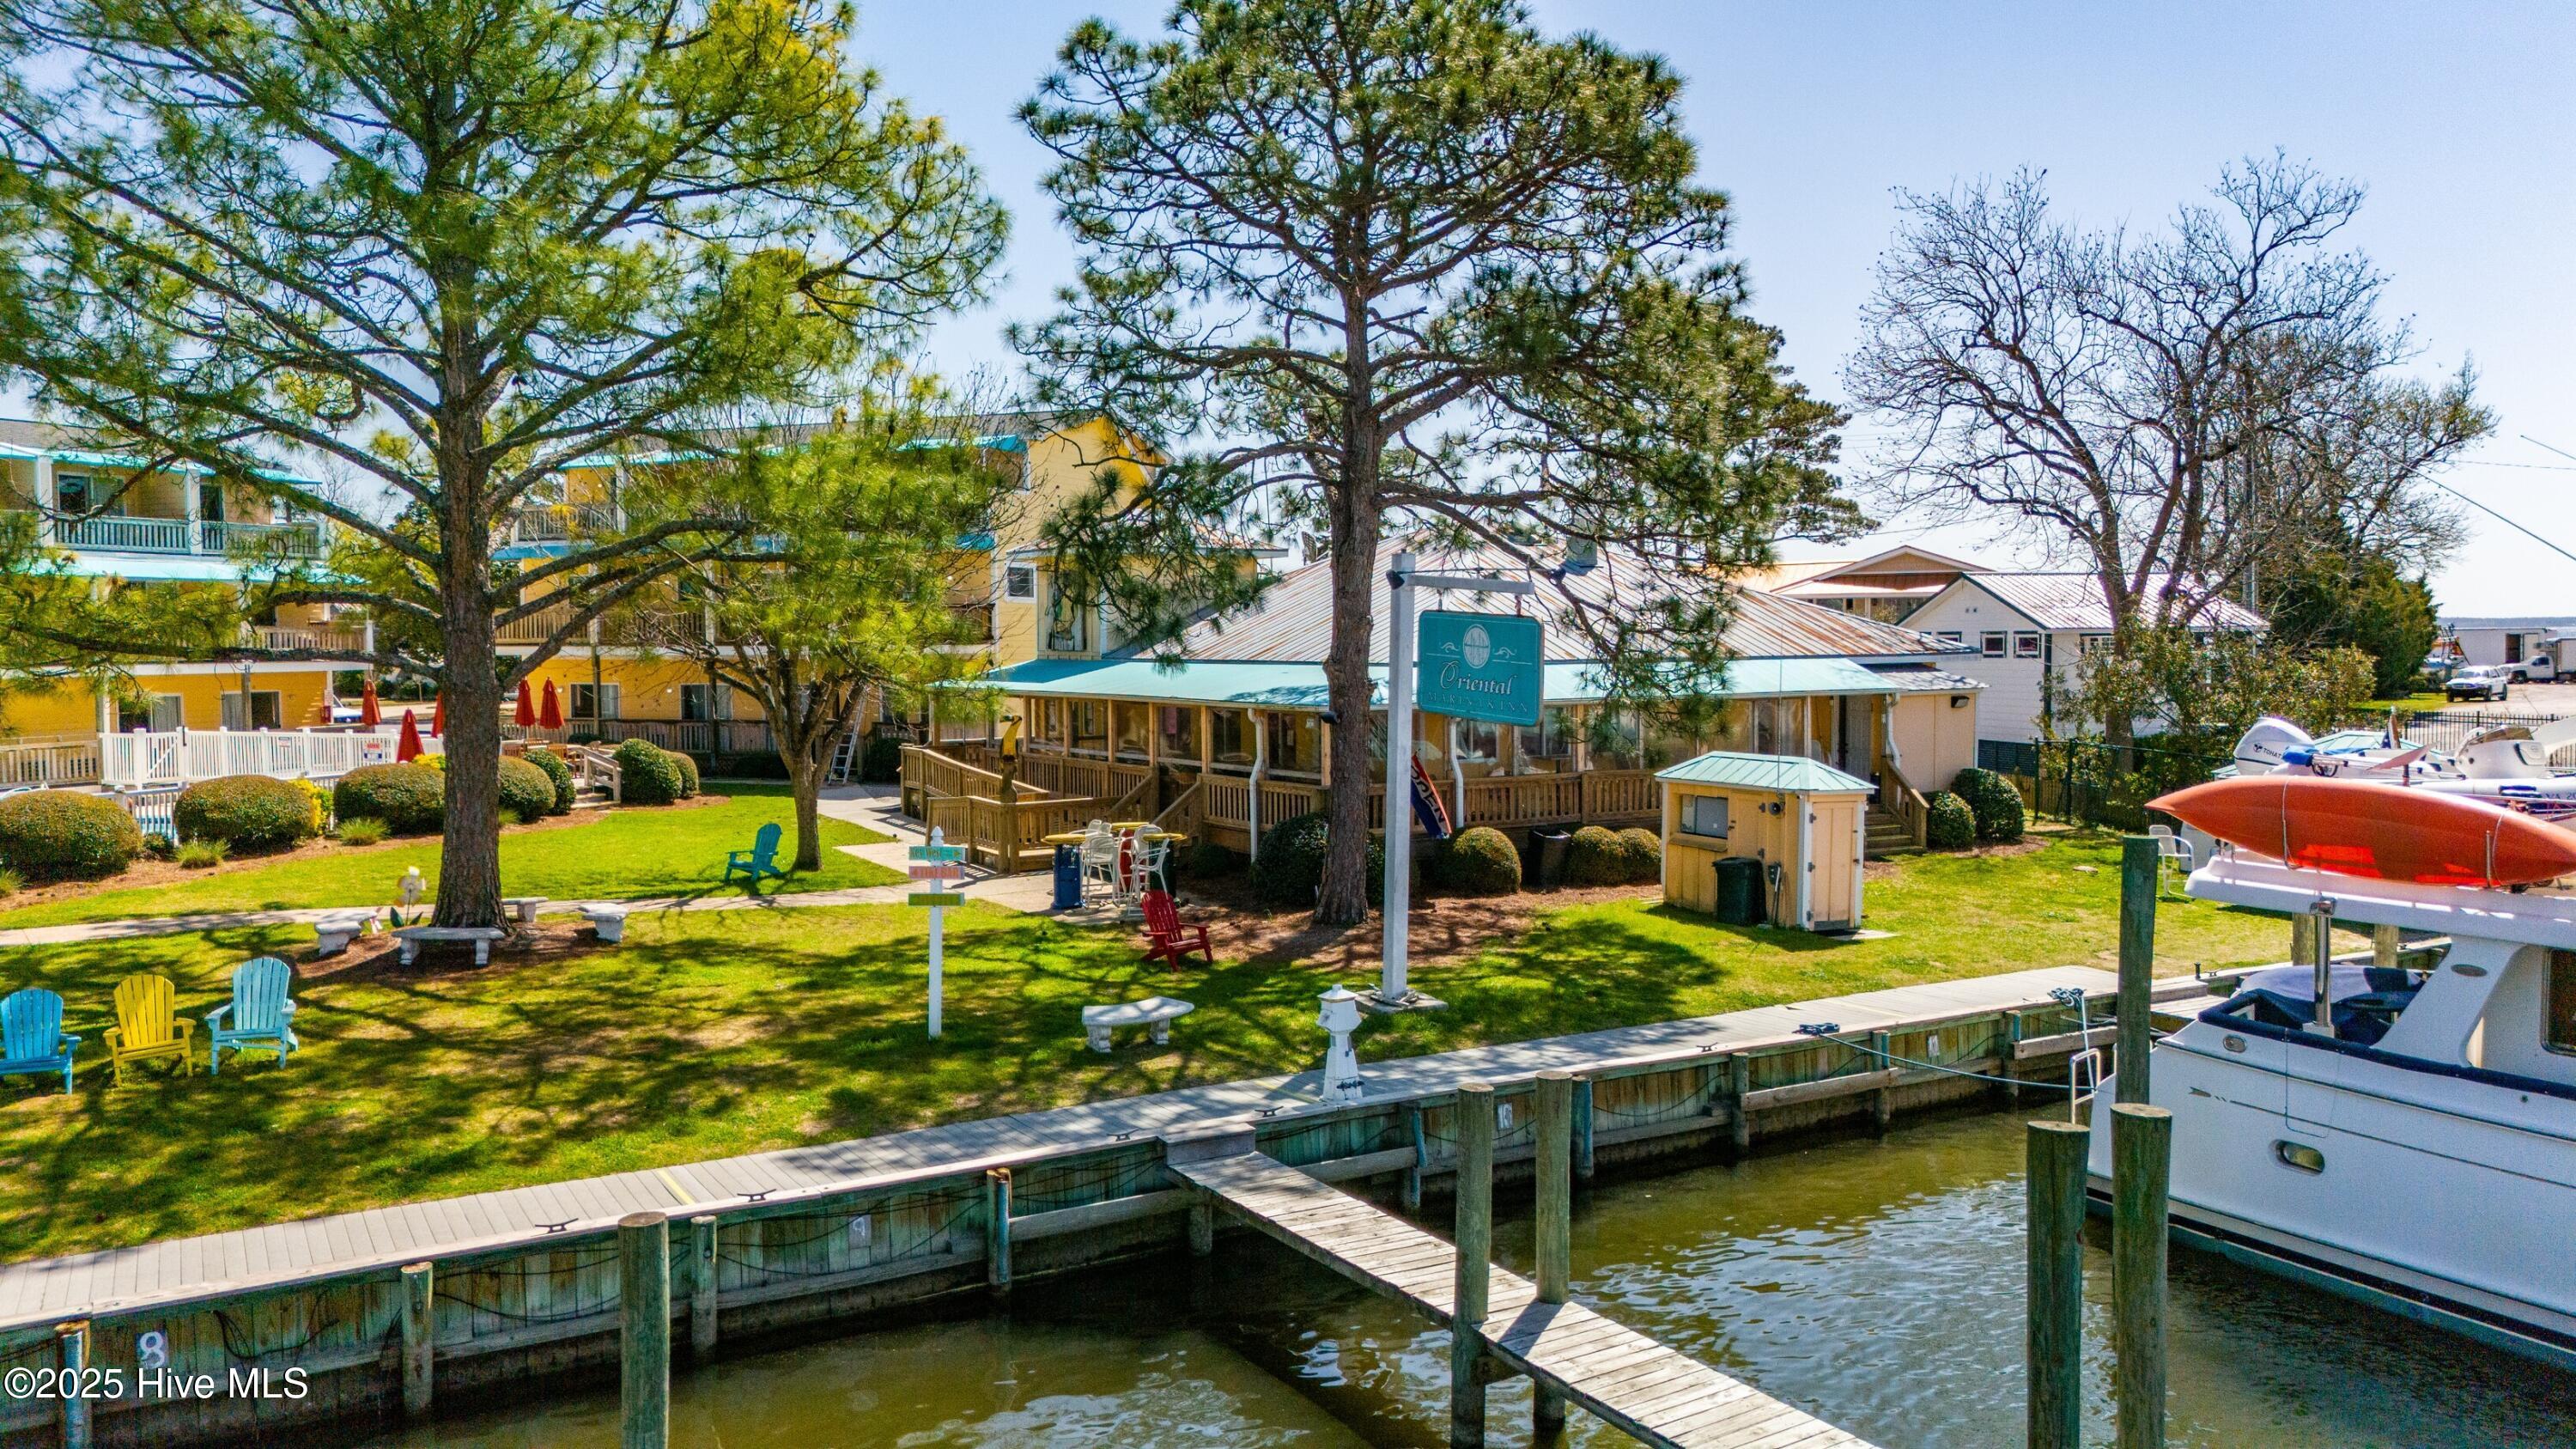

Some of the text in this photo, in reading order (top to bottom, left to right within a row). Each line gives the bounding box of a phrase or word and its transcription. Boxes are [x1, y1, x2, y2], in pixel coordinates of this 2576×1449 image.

[1440, 661, 1518, 696] Oriental
[2263, 747, 2281, 758] TOHAT
[140, 1331, 165, 1369] 8
